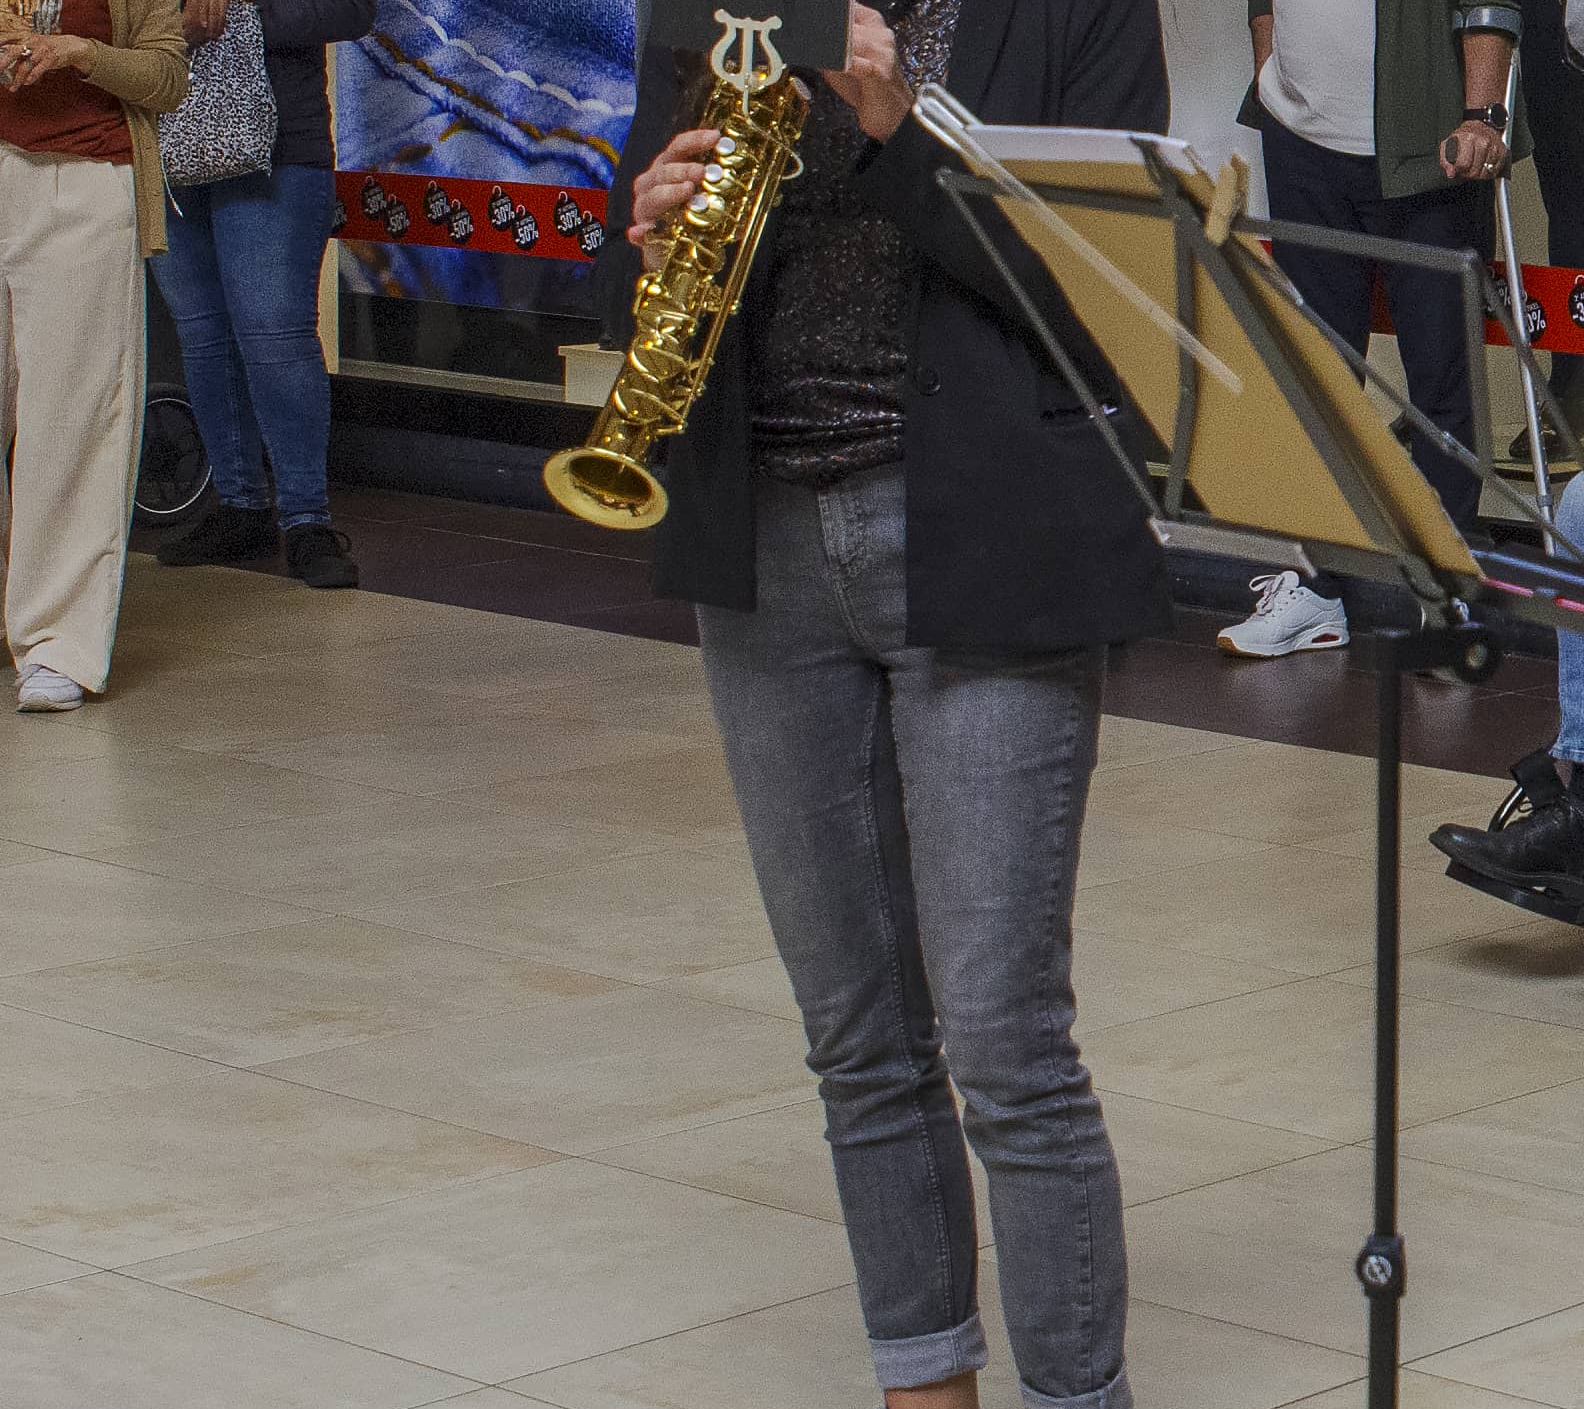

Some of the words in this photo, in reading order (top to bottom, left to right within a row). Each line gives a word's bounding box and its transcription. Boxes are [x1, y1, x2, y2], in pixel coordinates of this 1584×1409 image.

[491, 202, 515, 227] -30%
[556, 208, 582, 233] -30%
[515, 221, 539, 245] -50%
